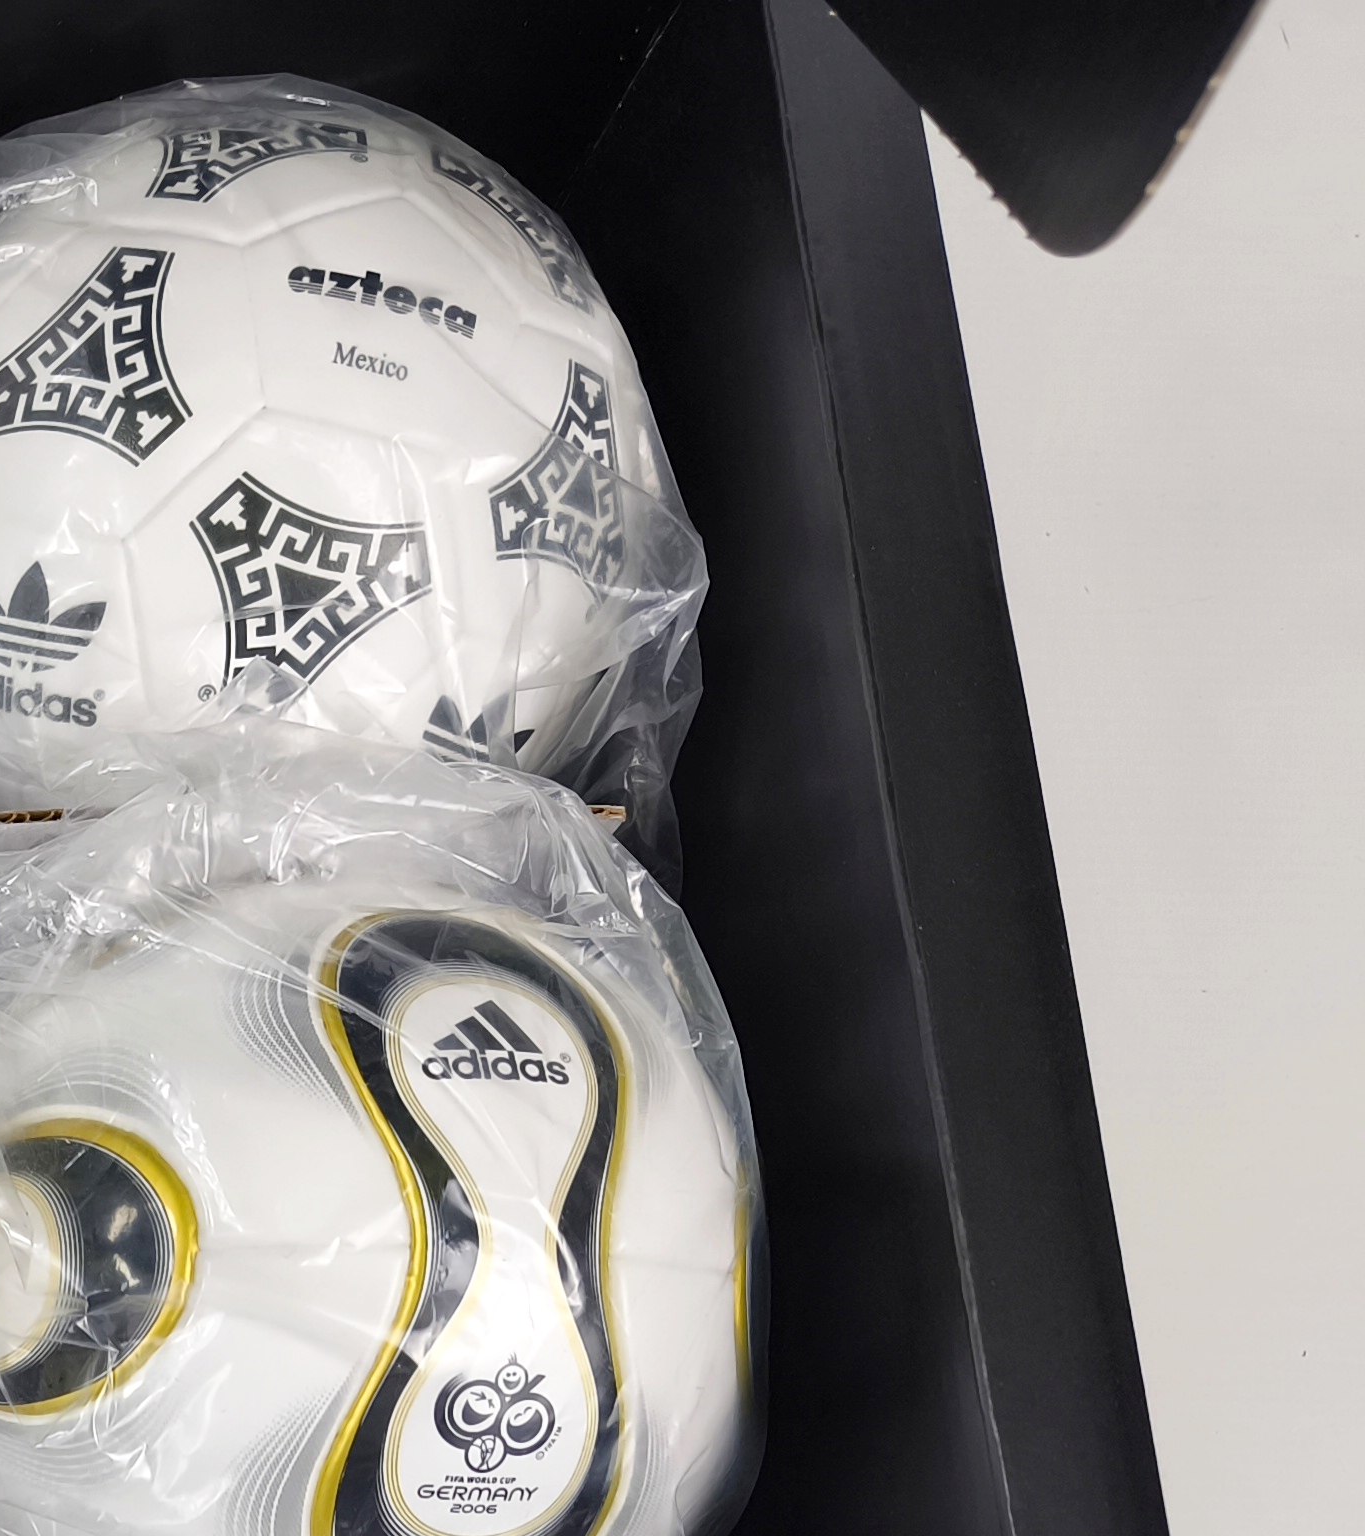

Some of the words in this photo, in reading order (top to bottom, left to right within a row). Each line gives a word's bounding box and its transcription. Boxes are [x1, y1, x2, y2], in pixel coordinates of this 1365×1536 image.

[288, 266, 477, 339] azteca
[332, 342, 408, 380] Mexico
[422, 1049, 569, 1085] adidas
[445, 1475, 464, 1484] FIFA
[417, 1485, 538, 1501] GERMANY
[450, 1504, 498, 1514] 2006
